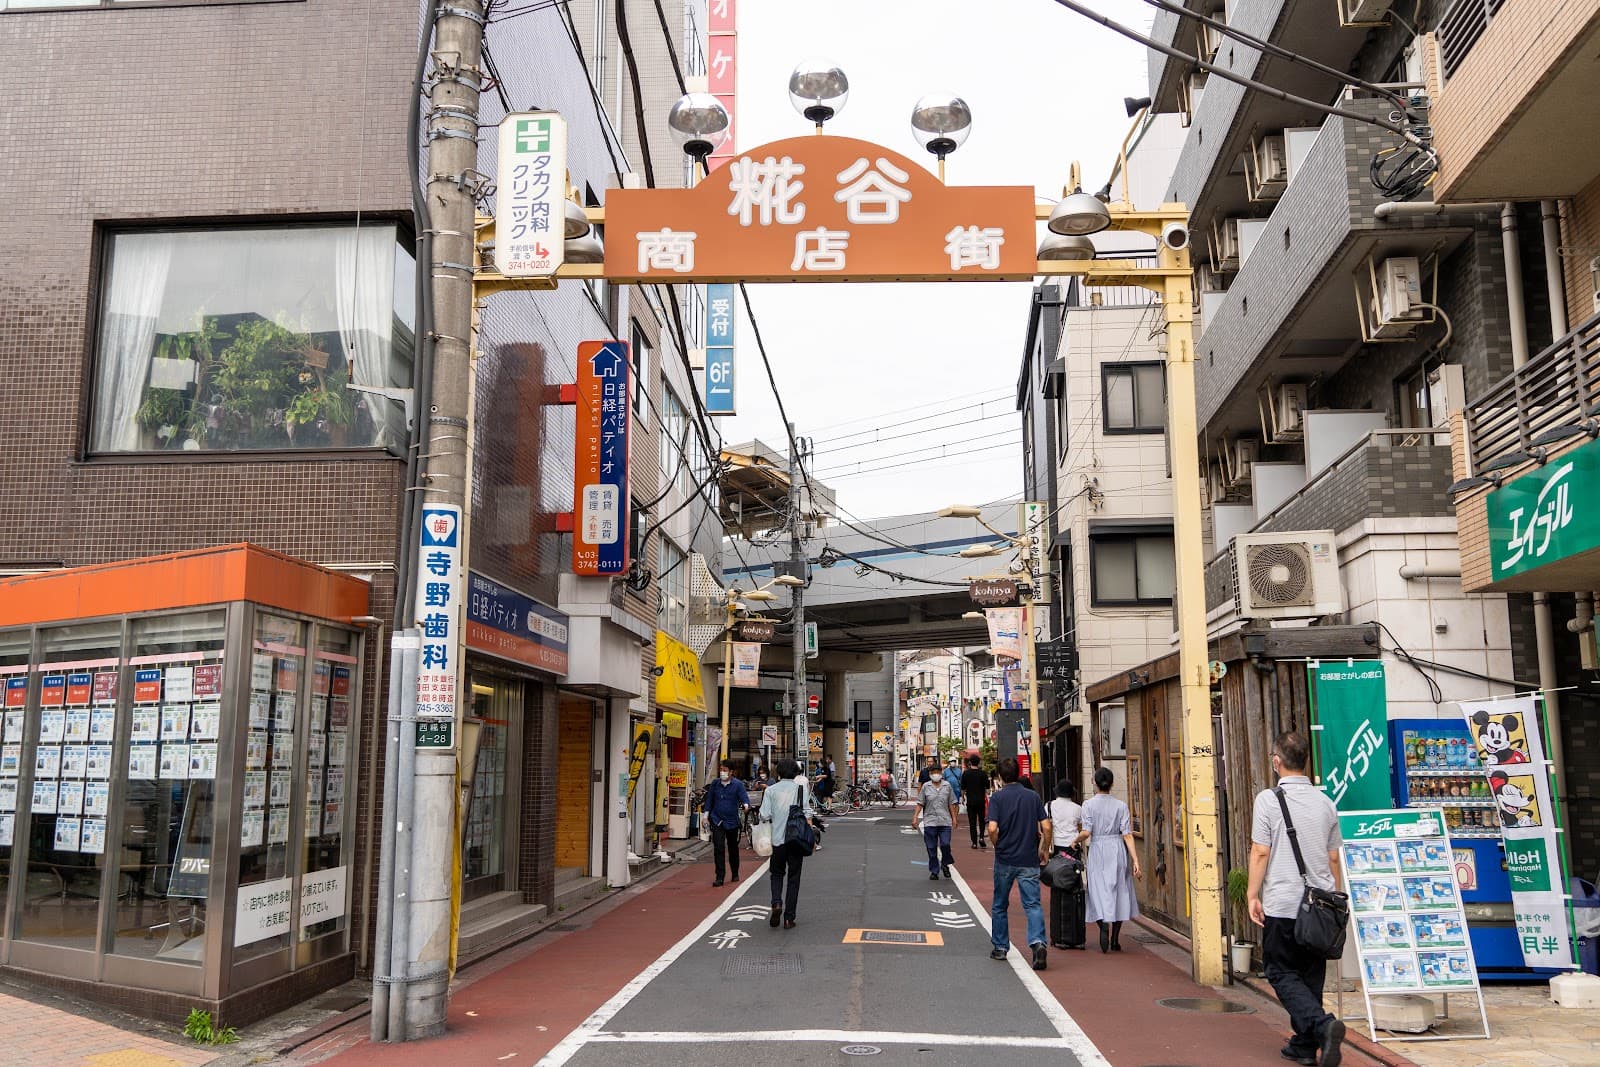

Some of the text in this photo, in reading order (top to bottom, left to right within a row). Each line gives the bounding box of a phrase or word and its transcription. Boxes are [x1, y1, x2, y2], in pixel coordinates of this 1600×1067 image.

[511, 164, 529, 239] クリニック
[530, 155, 551, 232] タカノ内科
[727, 156, 912, 226] 糀谷
[508, 260, 550, 269] 3741-0202
[711, 299, 729, 337] 受付
[709, 361, 731, 384] 6F
[589, 384, 600, 473] nikkei patio
[602, 383, 617, 474] 日経パティオ
[434, 519, 448, 534] 歯
[1501, 461, 1574, 571] エイブル
[578, 560, 622, 569] 3742-0111
[974, 585, 1012, 596] kohjiya
[422, 551, 452, 670] 寺野歯科
[472, 593, 517, 630] 日経パティオ
[419, 735, 447, 744] 4-28
[1326, 719, 1384, 805] エイブル
[1353, 817, 1393, 837] エイブル
